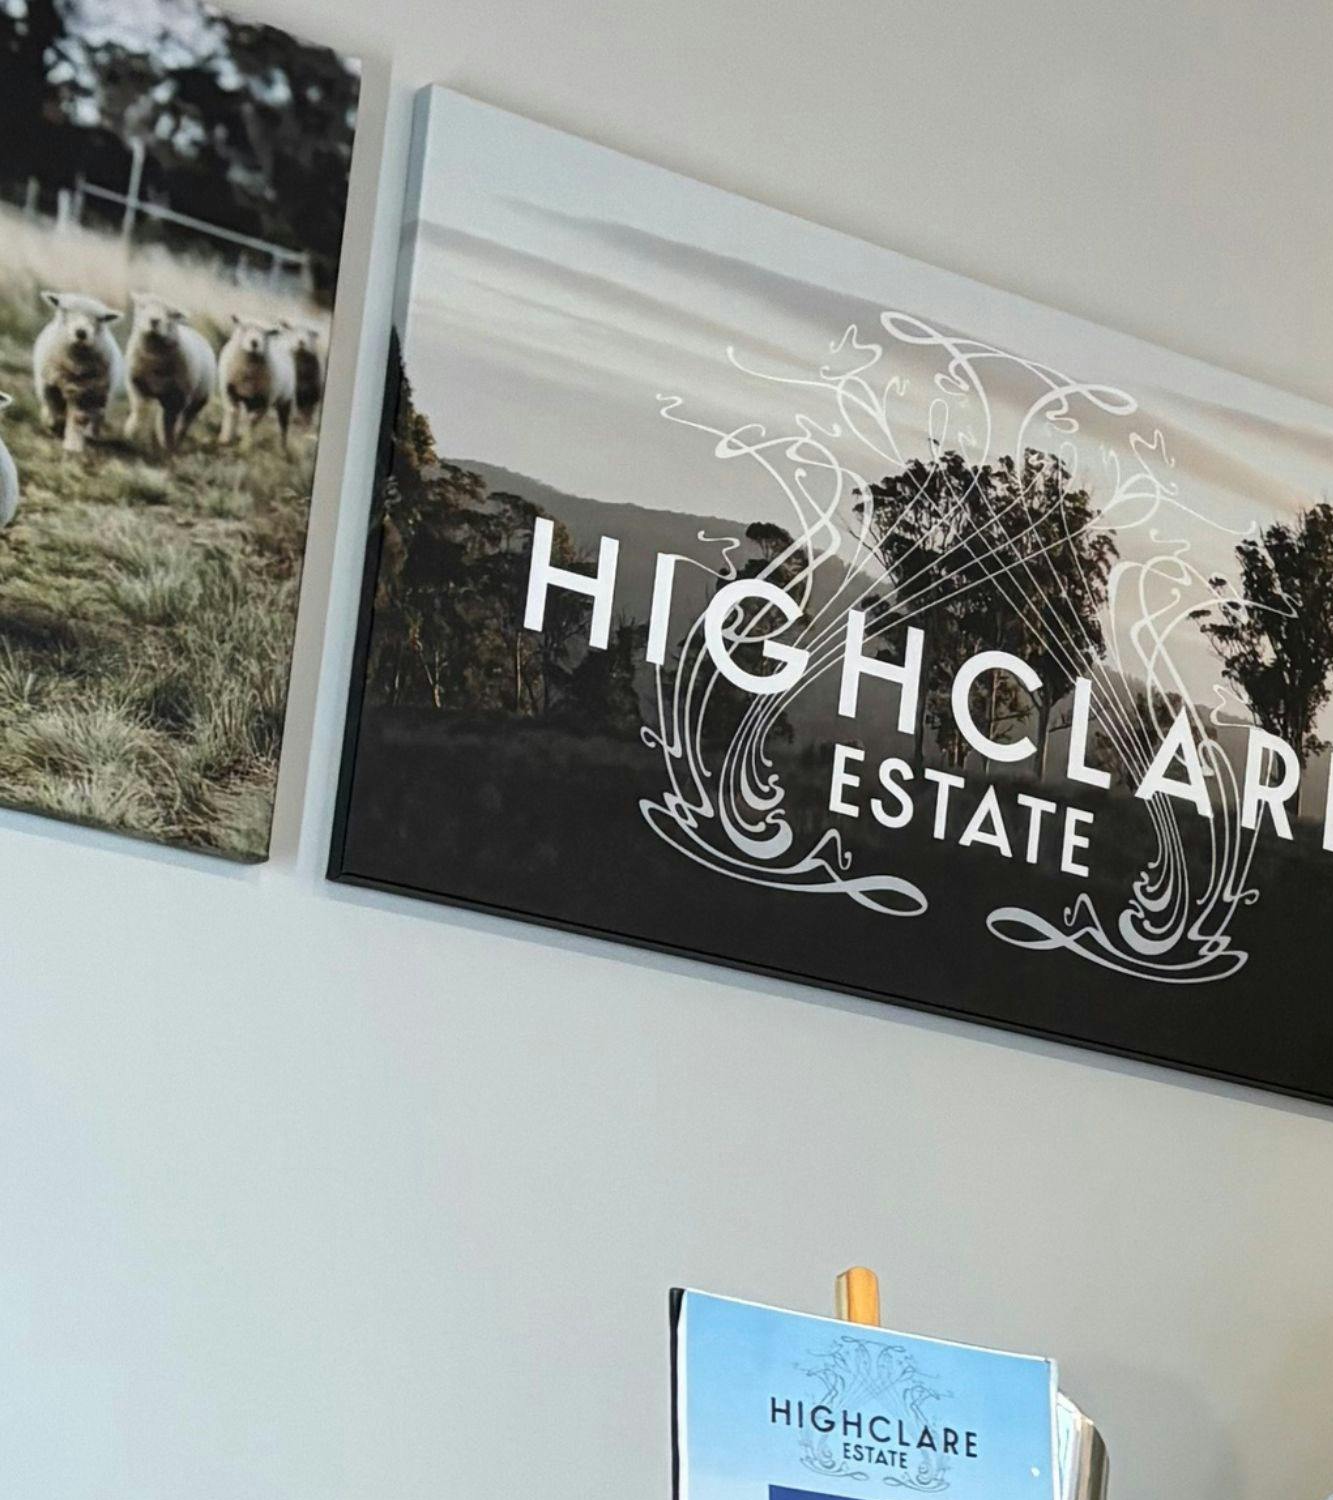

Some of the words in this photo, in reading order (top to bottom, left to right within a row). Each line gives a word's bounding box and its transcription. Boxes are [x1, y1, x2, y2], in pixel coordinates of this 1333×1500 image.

[827, 742, 1095, 878] ESTATE
[771, 1396, 978, 1458] HIGHCLARE
[842, 1442, 909, 1469] ESTATE
